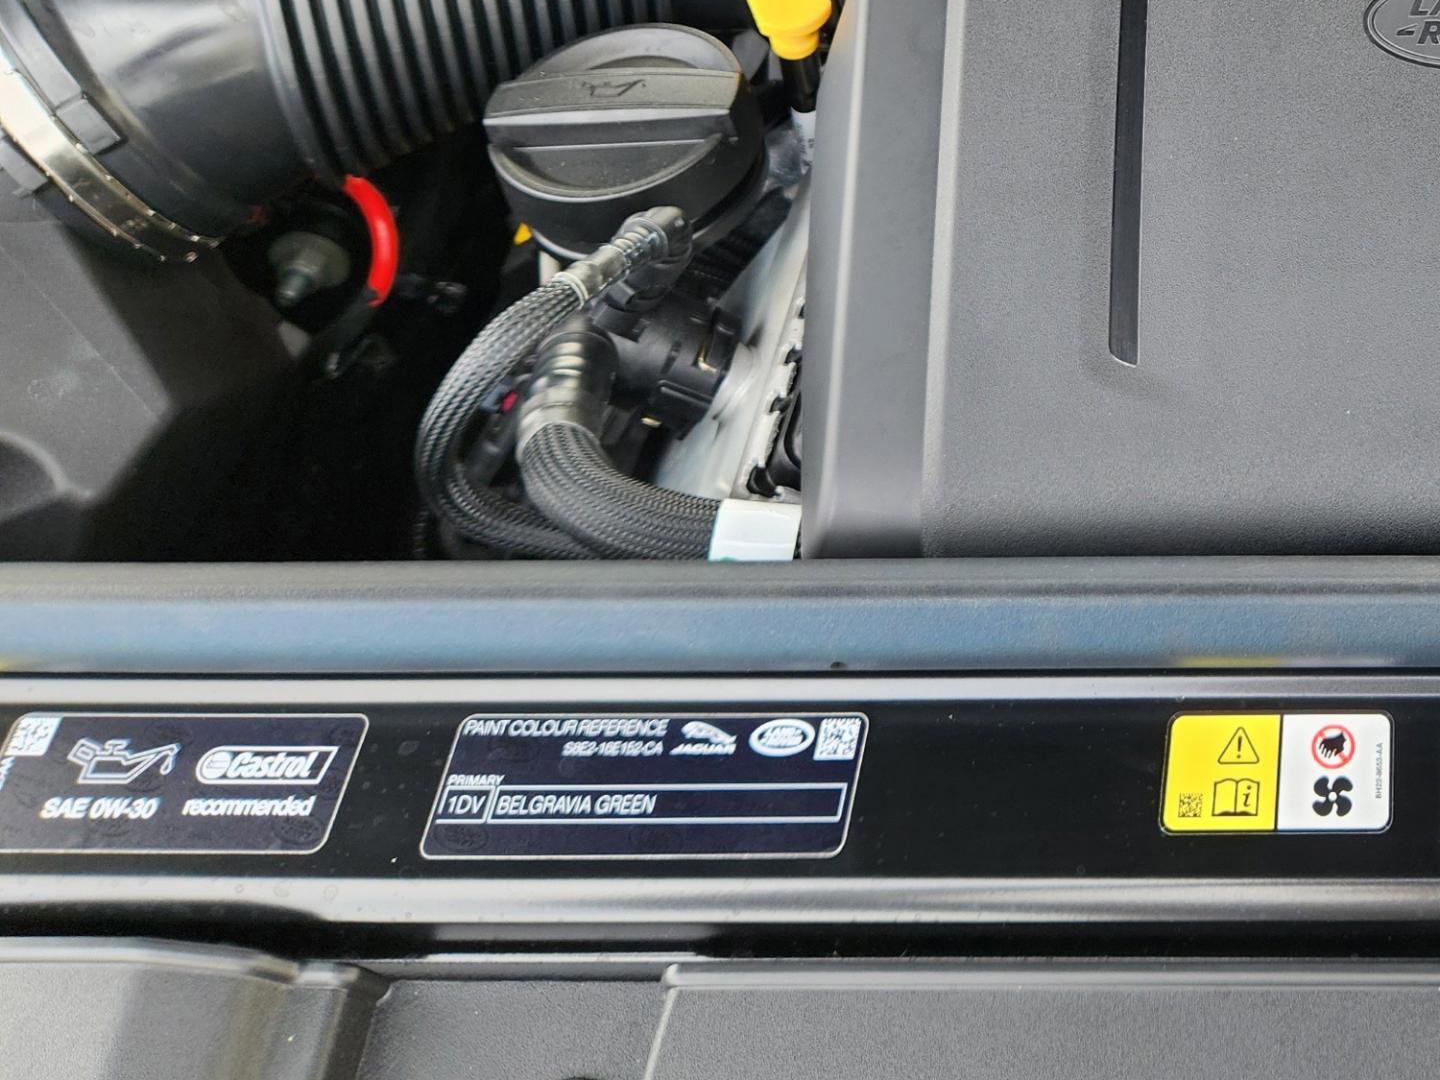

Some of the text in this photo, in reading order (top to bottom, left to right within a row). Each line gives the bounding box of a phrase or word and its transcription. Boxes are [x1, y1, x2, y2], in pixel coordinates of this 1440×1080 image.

[463, 719, 671, 737] PAINT COLOUR REFERENCE
[226, 751, 320, 779] Castrol
[446, 774, 505, 786] PRIMARY
[39, 796, 160, 819] SAE 0W-30
[181, 794, 317, 816] recommended
[448, 794, 658, 815] 1DV BELGRAVIA GREEN
